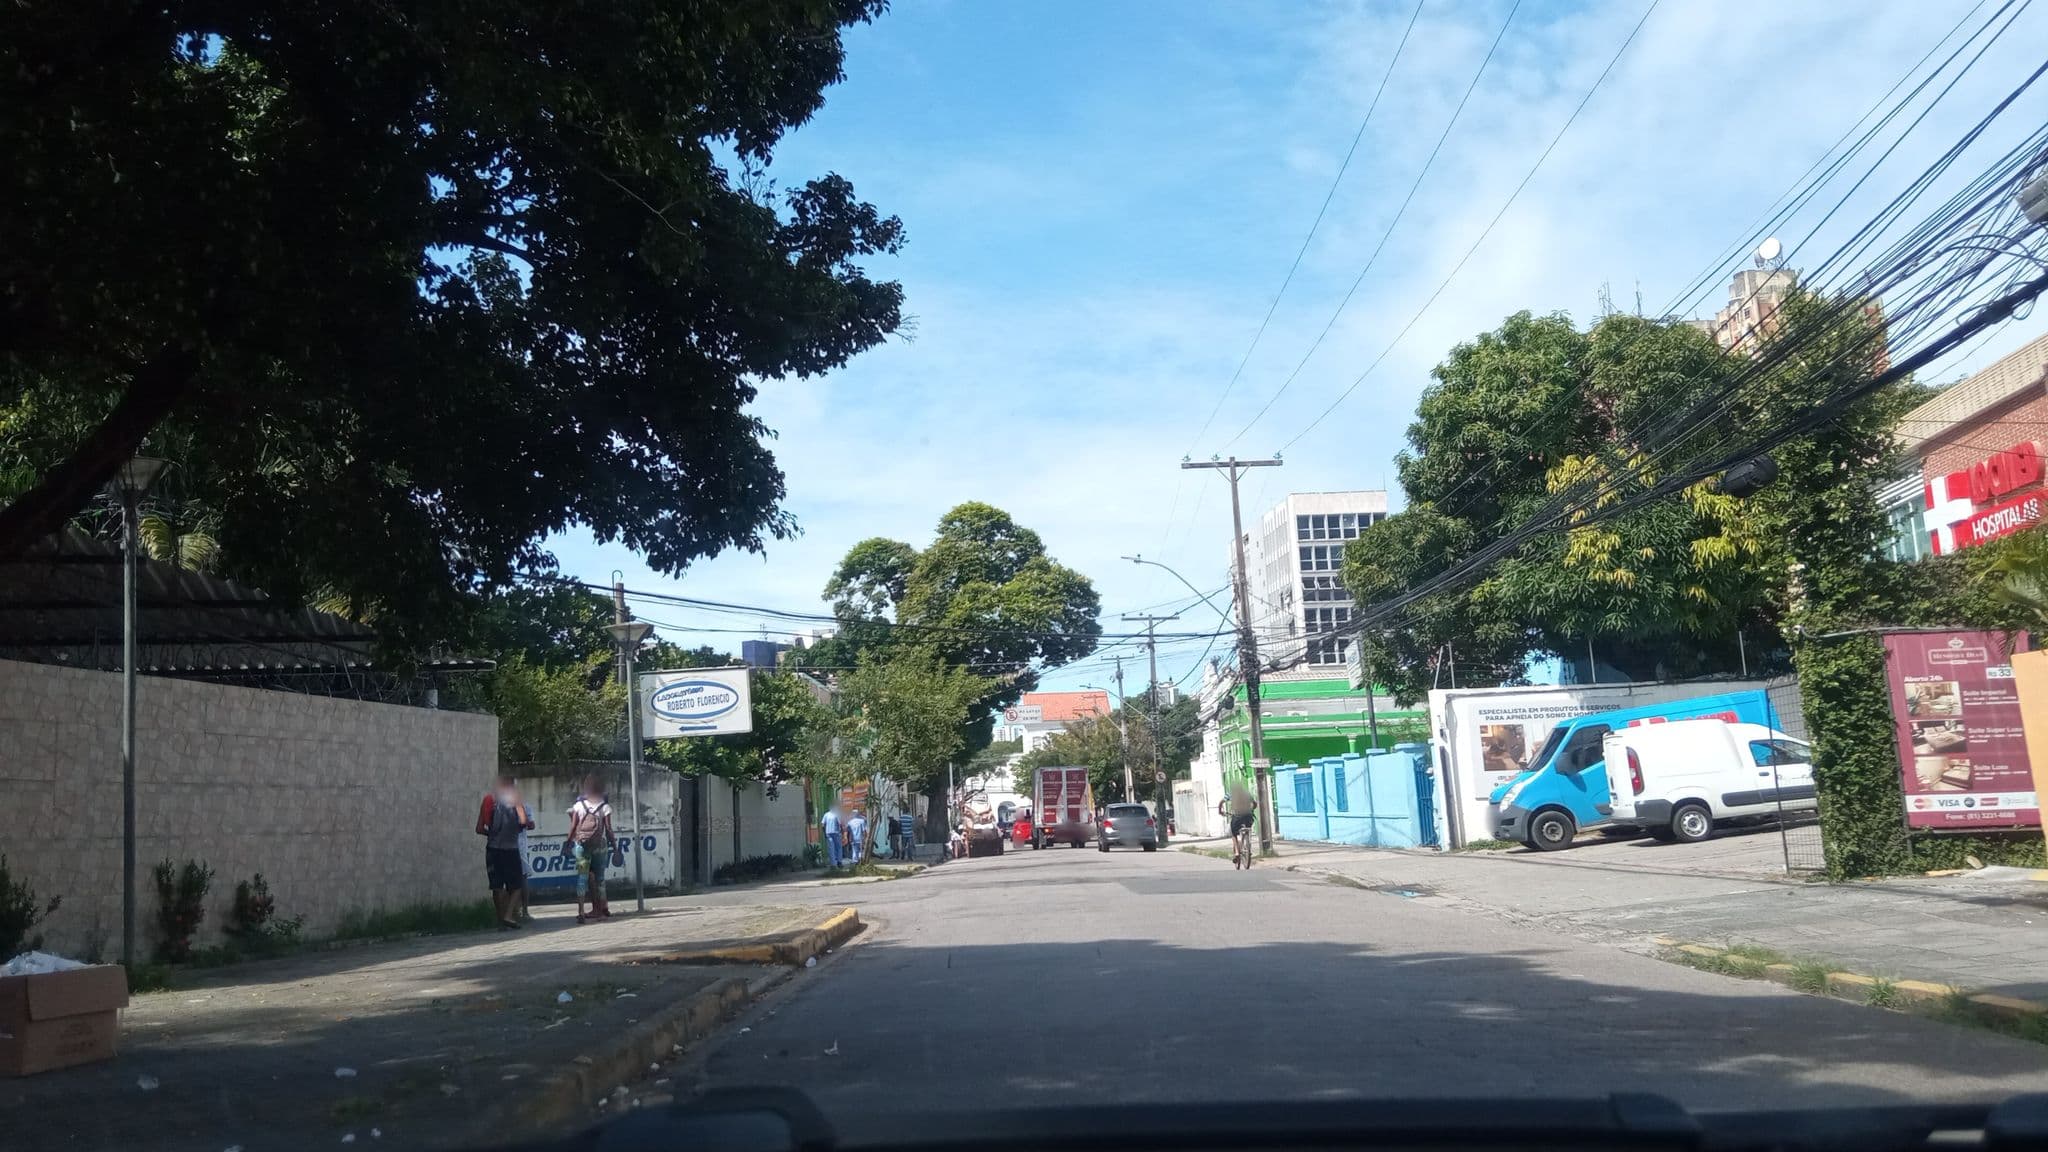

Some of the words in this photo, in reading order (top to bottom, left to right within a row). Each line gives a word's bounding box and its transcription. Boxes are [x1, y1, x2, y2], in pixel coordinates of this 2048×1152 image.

[667, 698, 695, 711] ROBERTO
[697, 693, 730, 706] FLORENCIO
[1479, 708, 1527, 716] ESPECIALISTA
[1938, 799, 1960, 807] VISA
